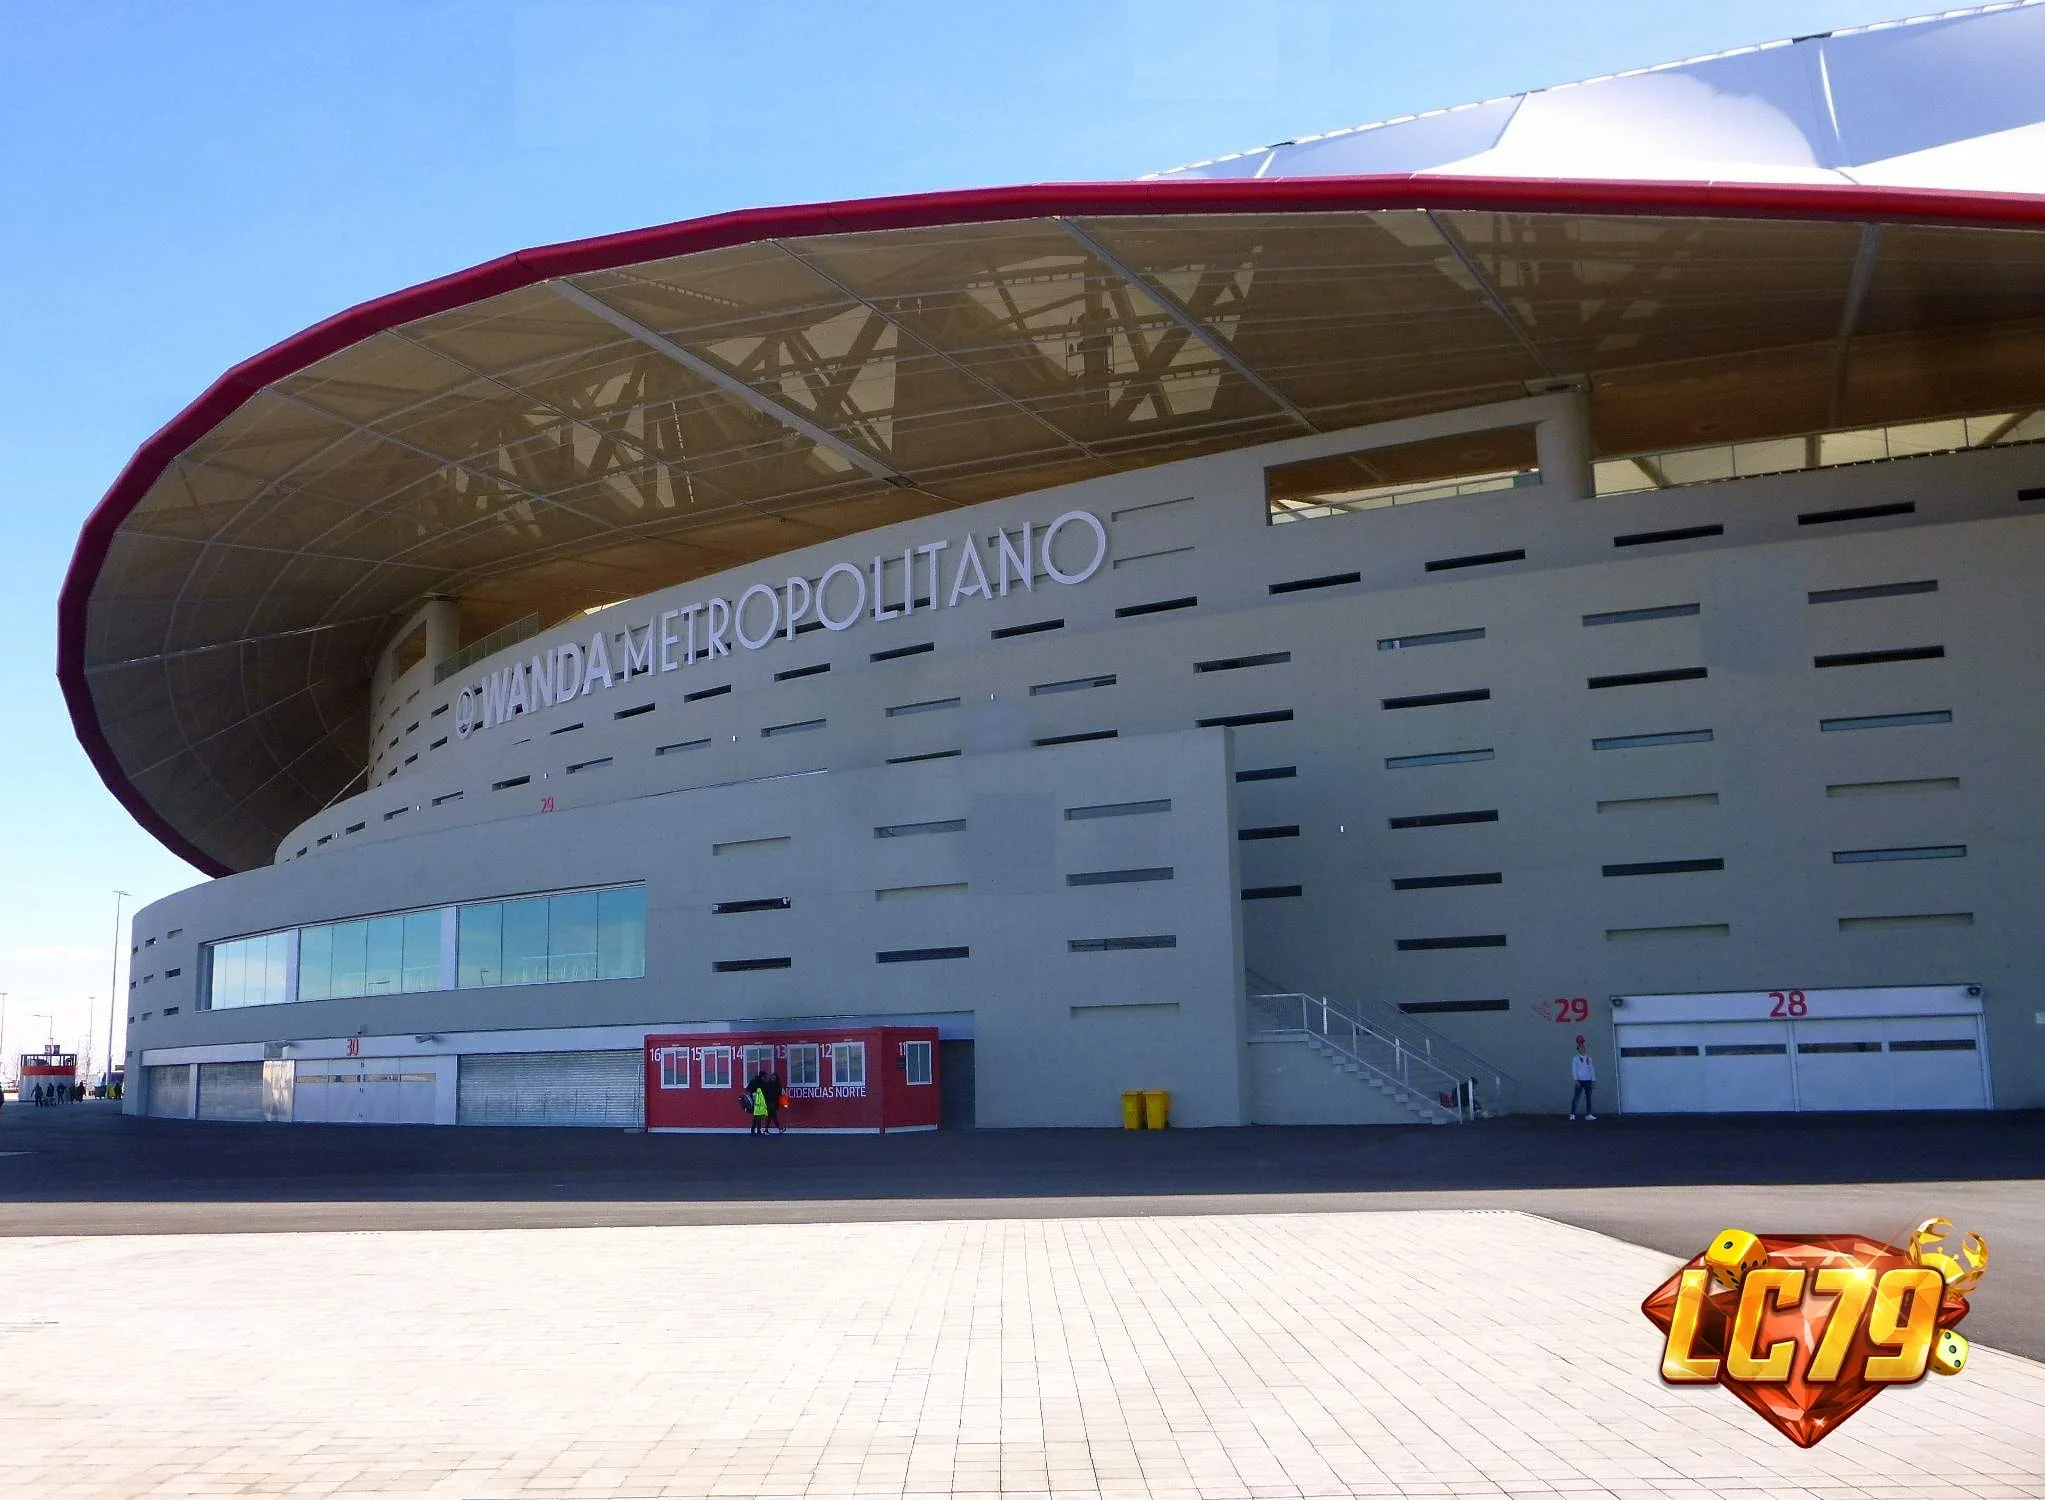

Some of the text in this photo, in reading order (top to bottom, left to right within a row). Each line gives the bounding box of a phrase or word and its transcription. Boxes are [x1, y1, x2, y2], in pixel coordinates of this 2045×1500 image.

[481, 510, 1108, 729] WANDA METROPOLITANO
[1554, 997, 1589, 1023] 29
[1769, 990, 1808, 1018] 28
[346, 1037, 359, 1057] 30
[649, 1047, 661, 1062] 16
[690, 1046, 702, 1061] 15
[731, 1045, 744, 1060] 14
[775, 1044, 788, 1059] 13
[820, 1043, 832, 1058] 12
[835, 1086, 867, 1098] NORTE
